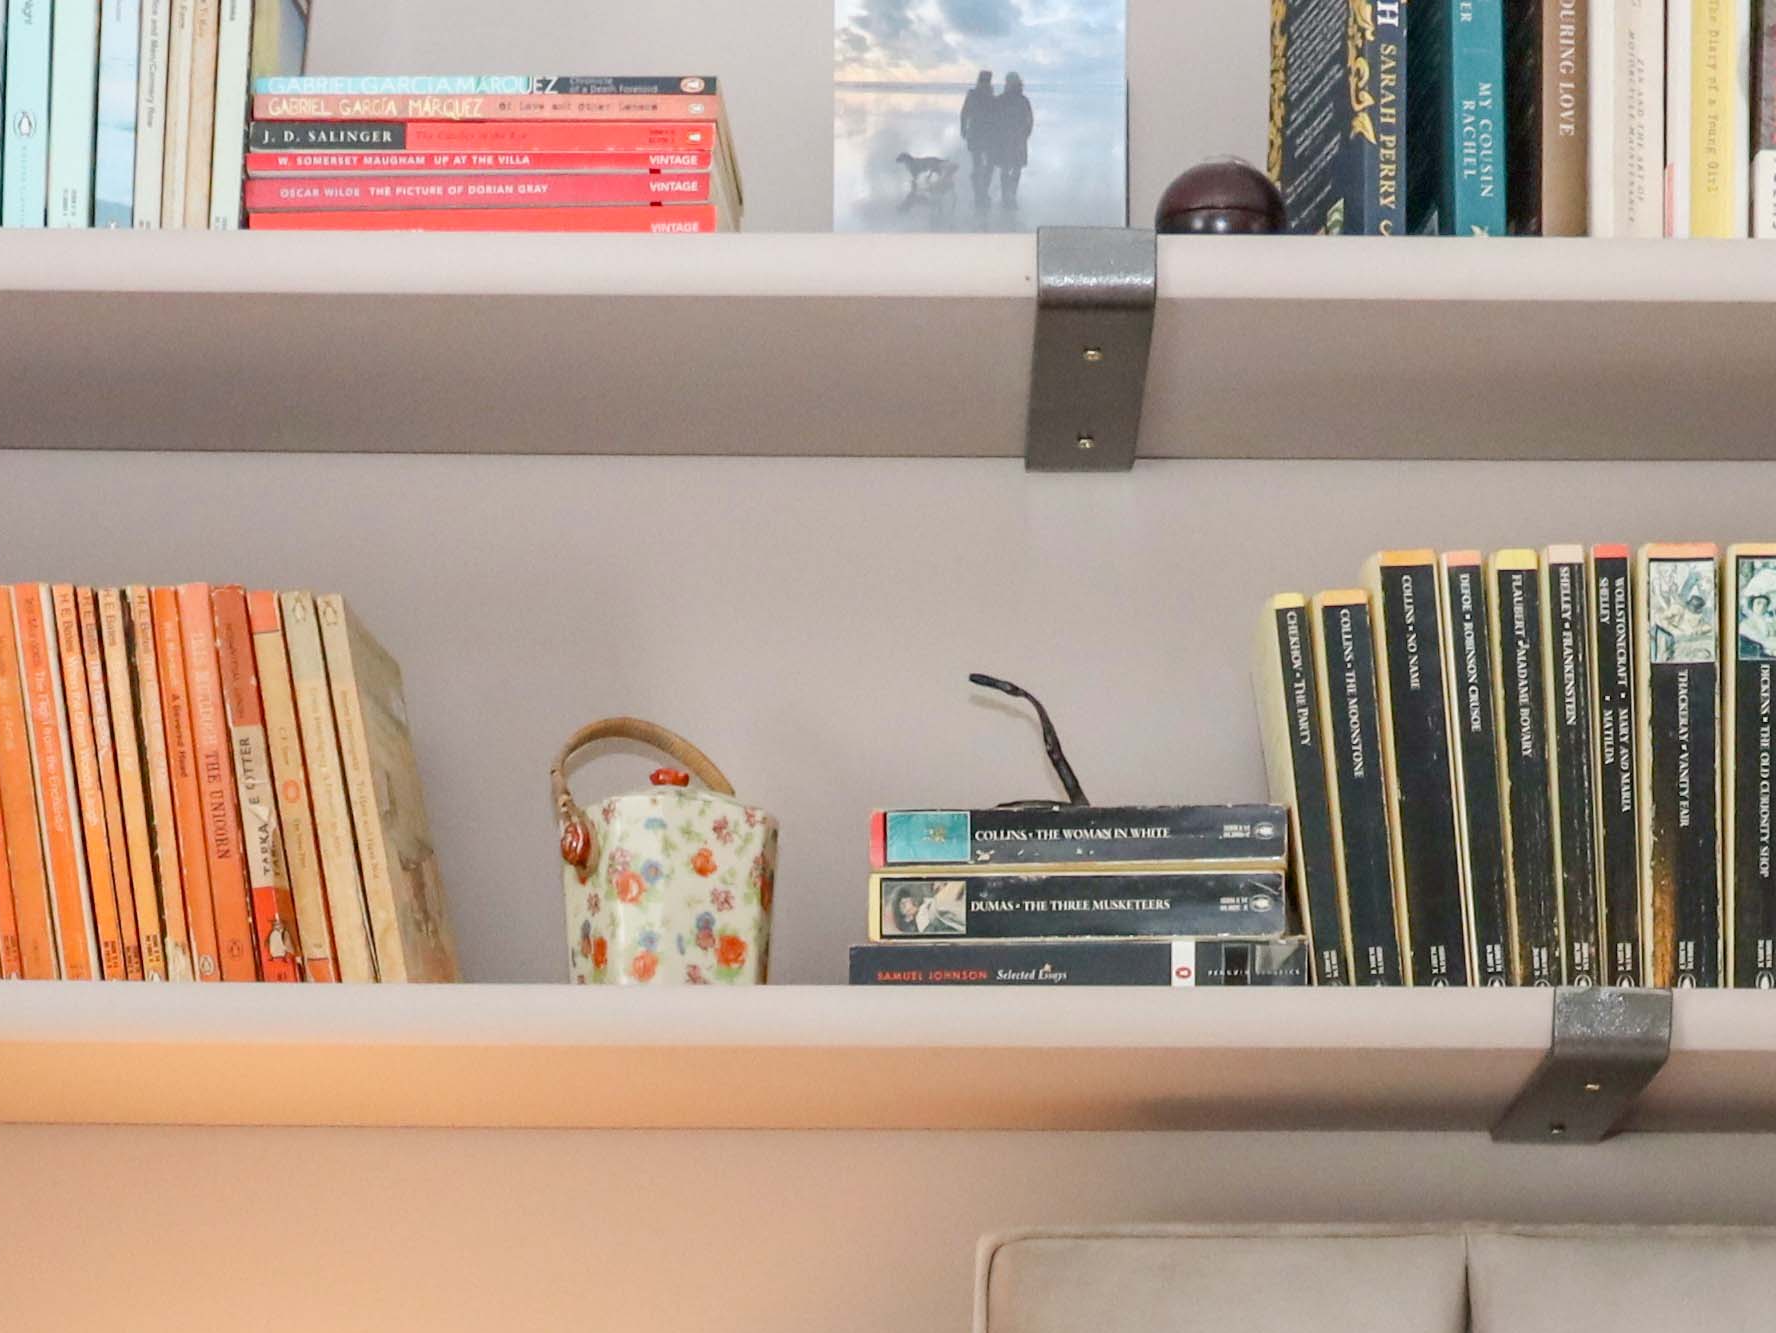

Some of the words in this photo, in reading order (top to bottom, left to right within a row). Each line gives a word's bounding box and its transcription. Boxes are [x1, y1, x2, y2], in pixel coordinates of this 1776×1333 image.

[1706, 29, 1719, 71] Diary
[267, 75, 355, 95] GABRIEL
[1379, 43, 1397, 123] SARAH
[1478, 81, 1493, 109] MY
[268, 98, 331, 117] GABRIEL
[407, 96, 482, 120] MÁRQUEZ
[1558, 82, 1575, 137] LOVE
[308, 129, 392, 143] SALINGER
[1462, 99, 1477, 180] RACHEL
[1706, 114, 1719, 153] Young
[434, 155, 450, 166] UP
[472, 155, 494, 165] THE
[498, 155, 531, 165] VILLA
[649, 154, 699, 166] VINTAGE
[1379, 134, 1397, 209] PERRY
[1479, 119, 1494, 197] COUSIN
[369, 186, 391, 197] THE
[395, 185, 443, 197] PICTURE
[649, 181, 699, 193] VINTAGE
[1400, 574, 1415, 624] COLLINS
[1458, 573, 1473, 612] DEFOE
[1558, 566, 1573, 621] SHELLEY
[1599, 576, 1611, 625] SHELLEY
[1286, 611, 1304, 671] CHEKHOV
[1339, 608, 1354, 663] COLLINS
[1405, 632, 1418, 653] NO
[1614, 576, 1628, 687] WOLLSTONECRAFT
[1407, 654, 1421, 690] NAME
[1462, 621, 1479, 684] ROBINSON
[1511, 574, 1526, 636] FLAUBERT
[1519, 707, 1533, 758] BOVARY
[1343, 669, 1357, 695] THE
[1562, 630, 1577, 726] FRANKENSTEIN
[1760, 664, 1771, 715] DICKENS
[1467, 685, 1483, 733] CRUSOE
[1618, 707, 1630, 743] MARY
[1677, 668, 1689, 742] THACKERAY
[1346, 697, 1365, 779] MOONSTONE
[1603, 709, 1615, 765] MATILDA
[1759, 724, 1771, 747] THE
[204, 751, 221, 784] THE
[1619, 745, 1631, 770] AND
[1678, 751, 1690, 800] VANITY
[1759, 752, 1770, 778] OLD
[1620, 772, 1632, 812] MARIA
[1758, 779, 1770, 842] CURIOSITY
[209, 790, 232, 860] UNICORN
[974, 829, 1028, 842] COLLINS
[1036, 828, 1061, 841] THE
[1063, 827, 1113, 840] WOMAN
[1114, 827, 1128, 839] IN
[1130, 825, 1170, 839] WHITE
[1679, 800, 1690, 828] FAIR
[1758, 846, 1770, 879] SHOP
[970, 900, 1014, 912] DUMAS
[1024, 900, 1048, 912] THE
[1050, 899, 1091, 911] THREE
[1091, 897, 1171, 911] MUSKETEERS
[877, 970, 925, 981] SAMUEL
[928, 969, 988, 981] JOHNSON
[996, 967, 1035, 982] Selected
